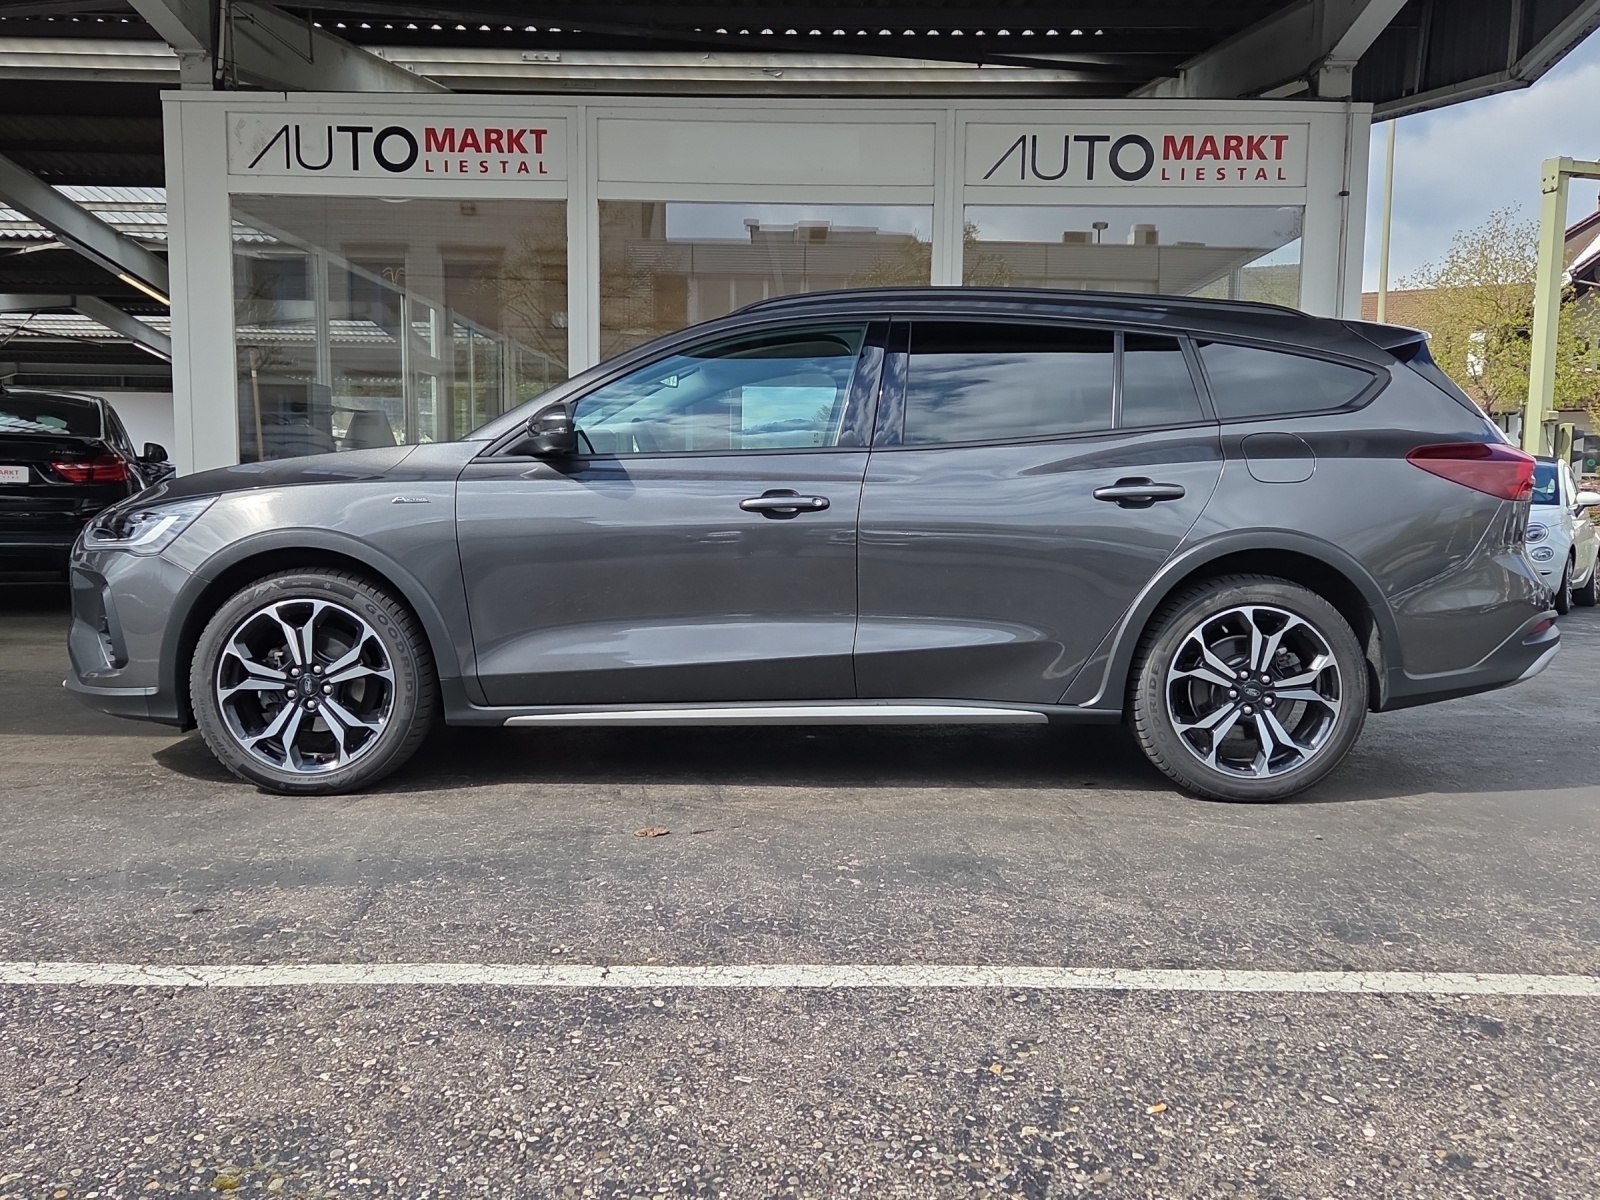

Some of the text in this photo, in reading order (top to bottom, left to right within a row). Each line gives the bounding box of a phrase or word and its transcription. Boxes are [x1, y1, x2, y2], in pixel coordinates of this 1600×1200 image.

[247, 124, 548, 173] AUTO MARKT
[425, 159, 548, 174] LIESTAL
[982, 134, 1289, 181] AUTO MARKT
[1161, 167, 1287, 181] LIESTAL
[365, 603, 413, 707] GOODRIDE
